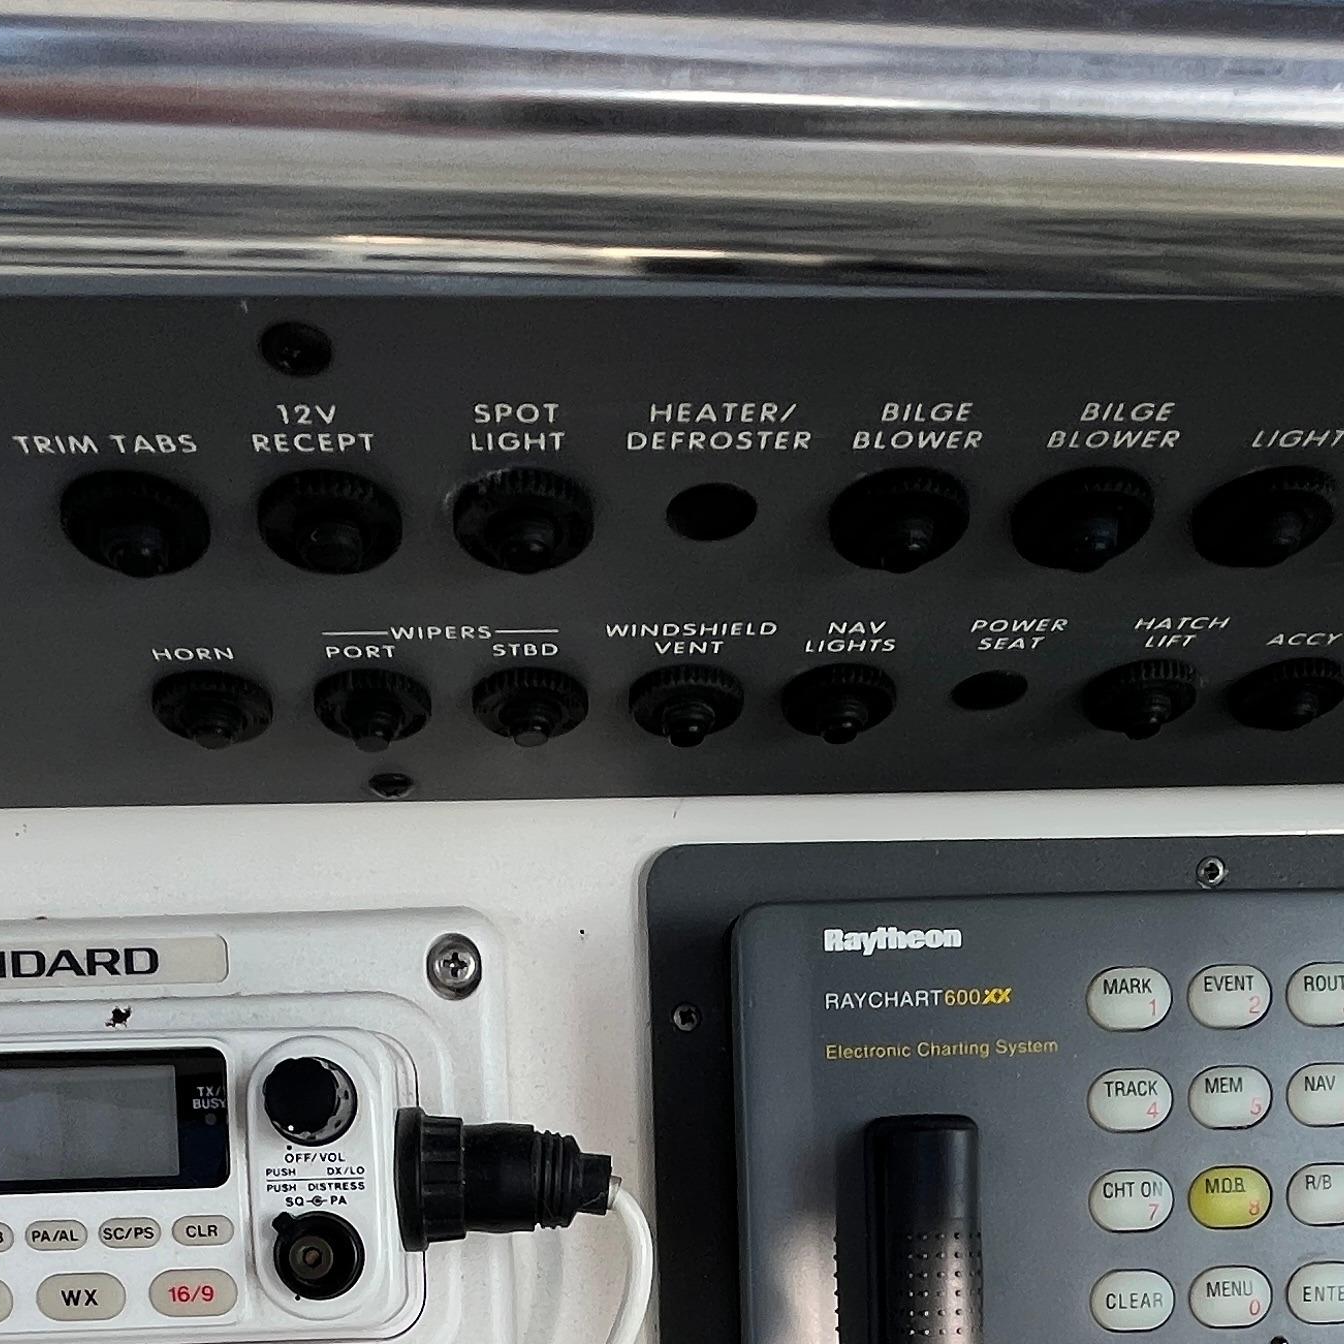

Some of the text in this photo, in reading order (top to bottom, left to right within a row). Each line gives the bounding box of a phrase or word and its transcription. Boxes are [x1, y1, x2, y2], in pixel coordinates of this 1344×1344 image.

[277, 404, 338, 425] 12V
[474, 403, 560, 424] SPOT
[649, 402, 798, 424] HEATER/
[881, 402, 974, 422] BILGE
[1080, 402, 1176, 422] BILGE
[13, 434, 199, 455] TRIM TABS
[252, 432, 375, 454] RECEPT
[470, 430, 567, 453] LIGHT
[626, 430, 813, 452] DEFROSTER
[852, 430, 984, 451] BLOWER
[1047, 429, 1181, 450] BLOWER
[605, 621, 779, 639] WINDSHIELD
[827, 620, 888, 636] NAV
[970, 617, 1070, 634] POWER
[1133, 615, 1232, 632] HATCH
[390, 625, 492, 641] WIPERS
[1144, 633, 1198, 650] LIFT
[1265, 631, 1340, 648] ACCY
[324, 642, 559, 660] PORT STBD
[654, 640, 725, 656] VENT
[804, 637, 897, 654] LIGHTS
[976, 636, 1047, 652] SEAT
[152, 647, 235, 662] HORN
[823, 926, 962, 956] Raytheon
[1103, 977, 1152, 995] MARK
[1203, 974, 1255, 993] EVENT
[1147, 998, 1158, 1018] 1
[1248, 996, 1261, 1014] 2
[825, 1037, 1059, 1061] Electronic Charting System
[196, 1086, 221, 1097] TX/
[1103, 1079, 1158, 1098] TRACK
[1204, 1076, 1244, 1094] MEM
[1304, 1074, 1336, 1092] NAV
[192, 1098, 226, 1110] BUSY
[1145, 1101, 1159, 1118] 4
[1250, 1096, 1263, 1116] 5
[284, 1152, 346, 1164] OFF/VOL
[265, 1165, 366, 1178] PUSH DX/LO
[266, 1181, 366, 1193] PUSH DISTRESS
[1102, 1179, 1164, 1199] CHT ON
[1304, 1173, 1333, 1191] R/B
[329, 1195, 348, 1206] PA
[1248, 1199, 1261, 1216] 8
[1147, 1203, 1160, 1222] 7
[31, 1229, 79, 1243] PA/AL
[102, 1226, 155, 1241] SC/PS
[185, 1224, 218, 1239] CLR
[61, 1289, 99, 1307] WX
[168, 1285, 215, 1303] 16/9
[1206, 1280, 1254, 1298] MENU
[1105, 1291, 1164, 1310] CLEAR
